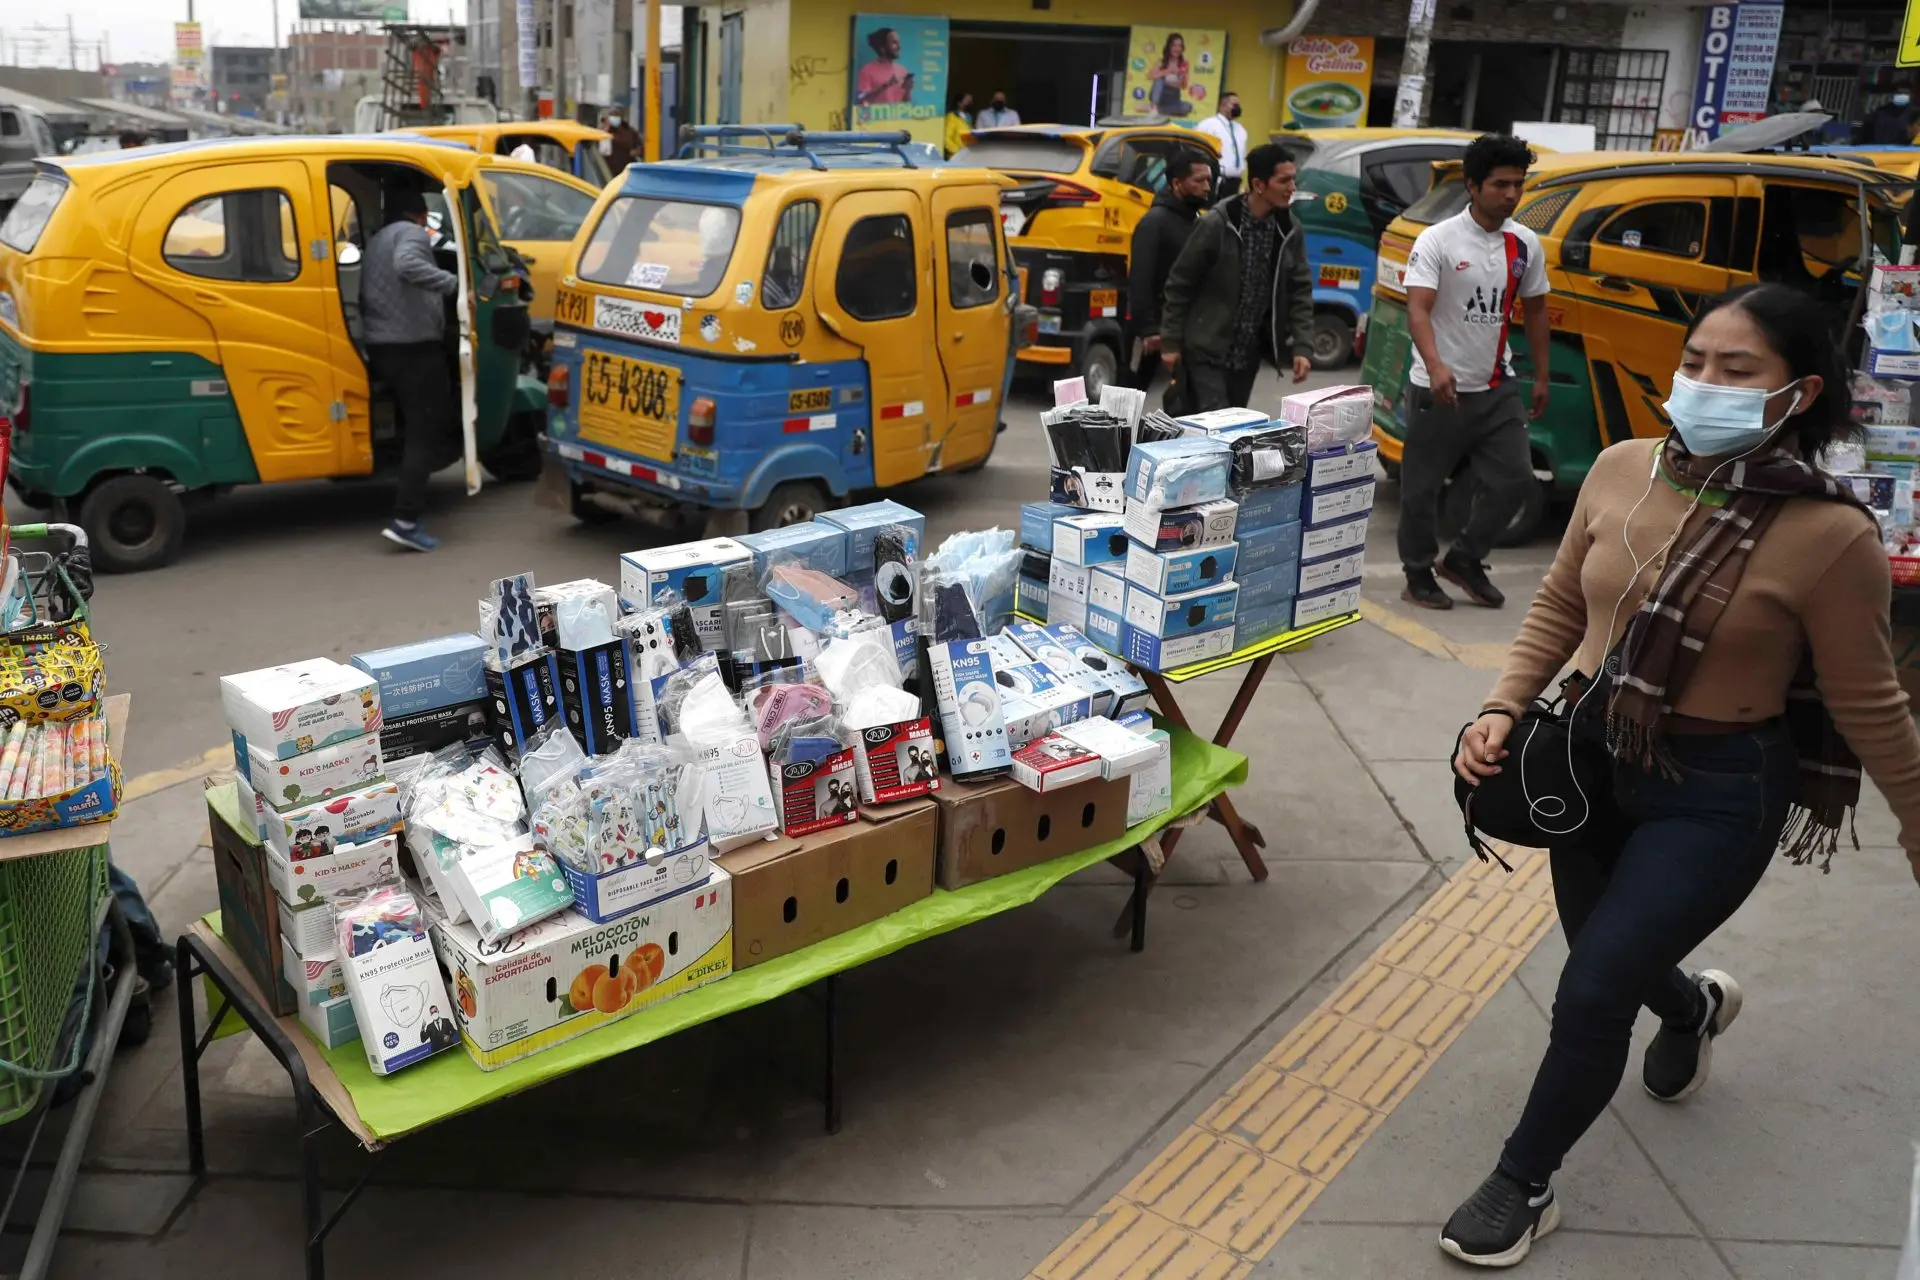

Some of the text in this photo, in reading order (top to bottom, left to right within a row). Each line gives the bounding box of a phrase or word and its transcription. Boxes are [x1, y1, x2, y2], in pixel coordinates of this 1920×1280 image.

[1289, 37, 1358, 56] Caldo de
[1307, 54, 1367, 73] Gallina
[895, 635, 915, 648] KN95
[952, 657, 980, 668] KN95
[530, 692, 544, 724] MASK
[600, 674, 616, 736] KN95 MASK
[764, 692, 785, 730] USO CIVIL
[298, 710, 328, 722] DISPOSABLE
[298, 720, 310, 728] FACE
[407, 714, 438, 728] PROTECTIVE
[438, 710, 453, 720] MASK
[909, 728, 931, 740] MASK
[300, 757, 350, 777] KID'S MASKS
[832, 760, 853, 773] MASK
[68, 798, 100, 812] BOLSITAS
[84, 792, 98, 802] 24
[344, 809, 376, 824] Disposable
[344, 820, 361, 830] Mask
[314, 859, 366, 878] KID'S MASKS
[608, 874, 668, 897] DISPOSABLE FACE MASK
[586, 932, 638, 959] HUAYCO
[360, 966, 378, 980] KN95
[379, 955, 414, 973] Protective
[414, 948, 432, 960] Mask
[495, 952, 542, 973] Calidad de
[696, 960, 728, 978] DIKEL
